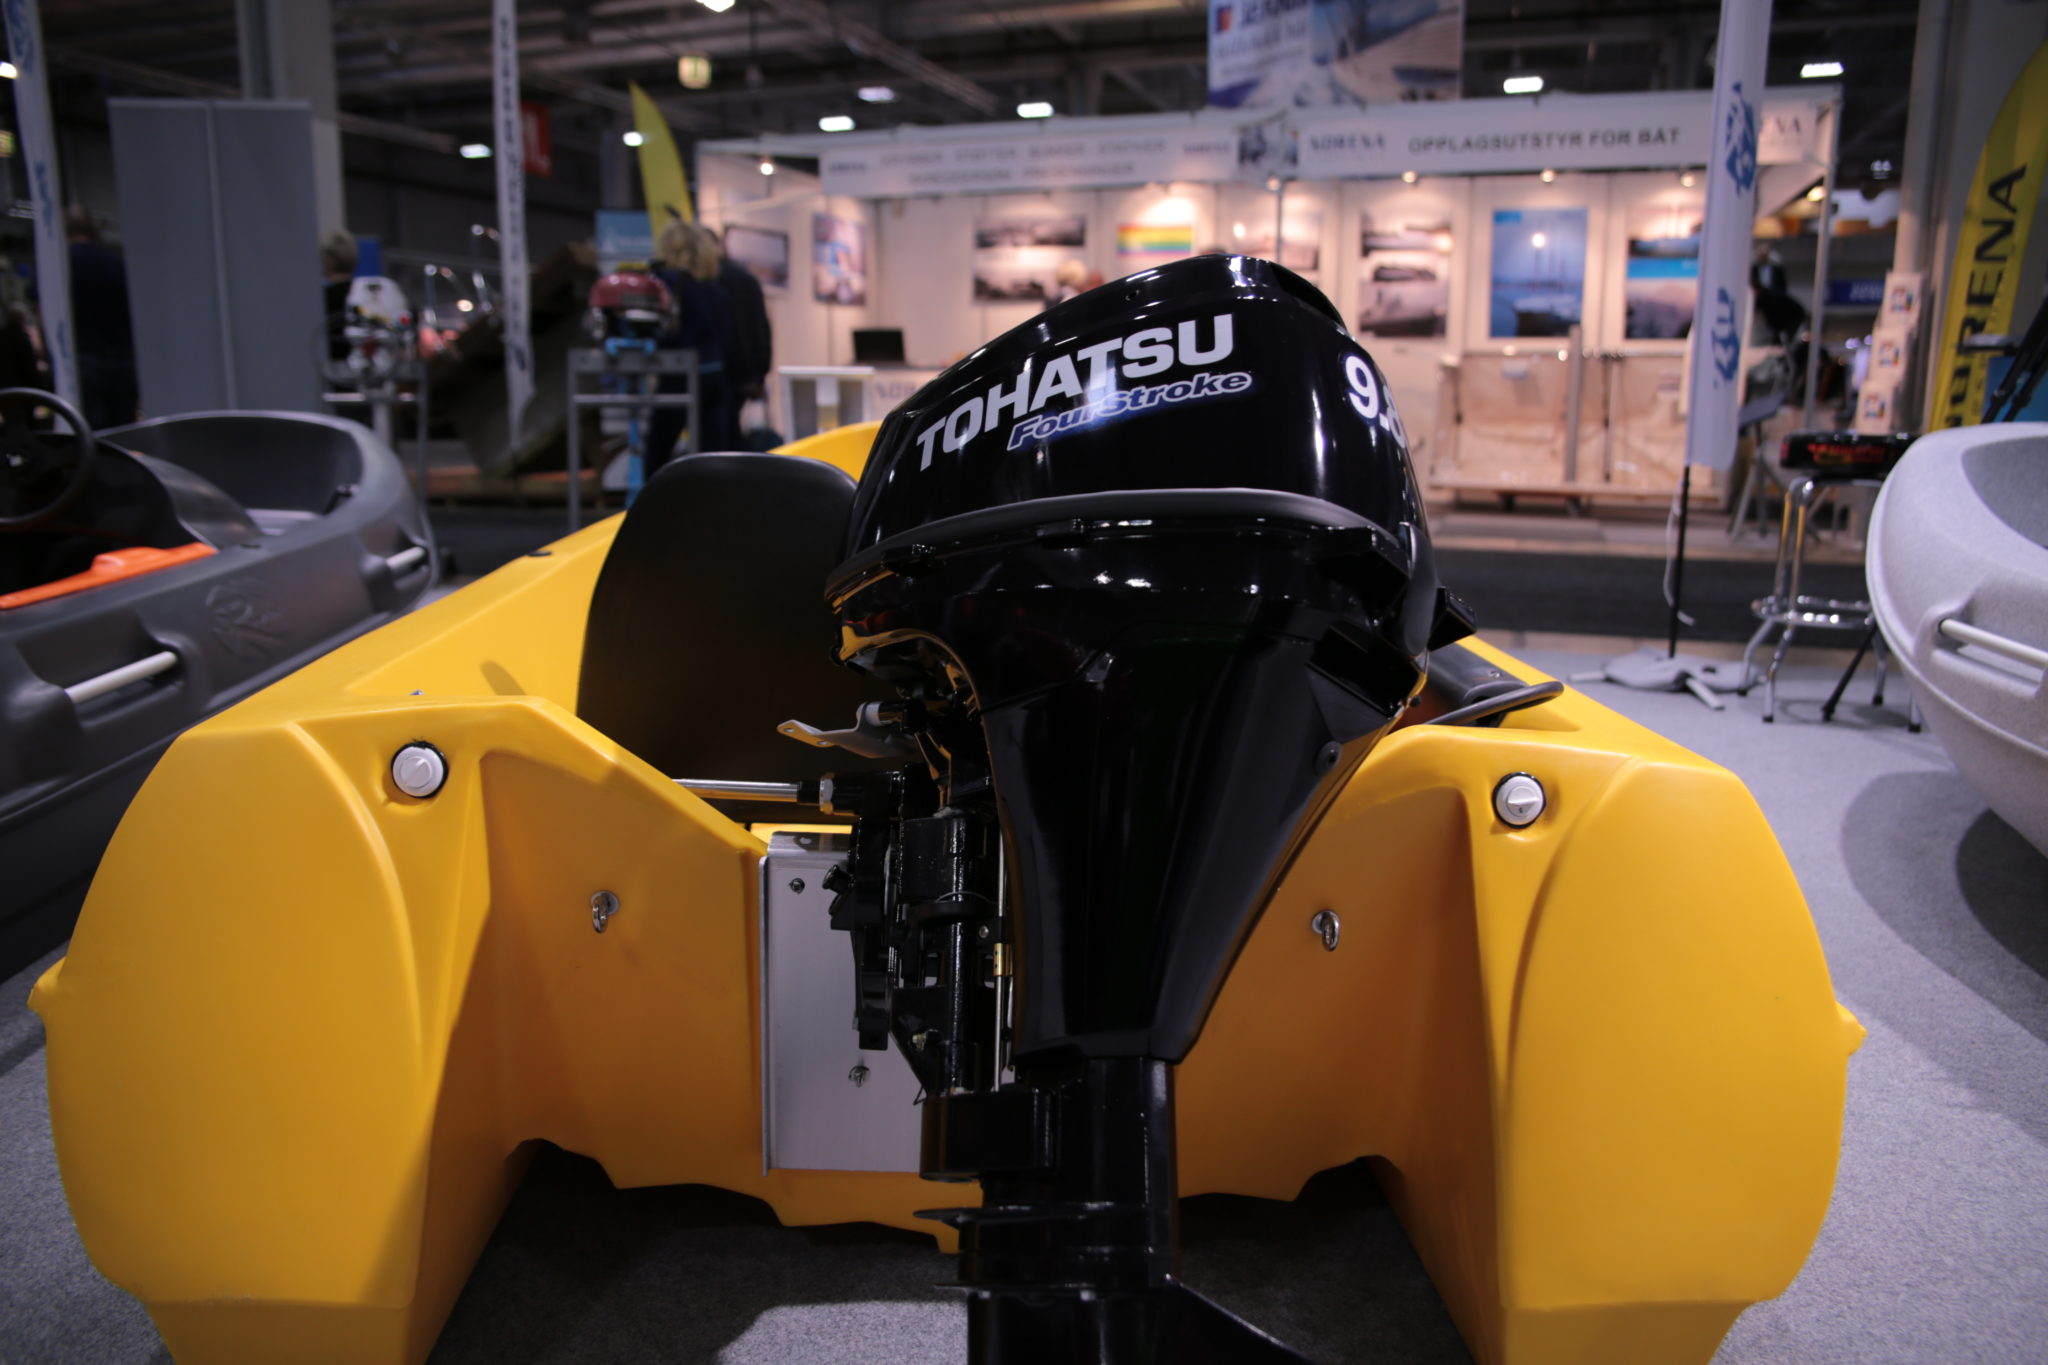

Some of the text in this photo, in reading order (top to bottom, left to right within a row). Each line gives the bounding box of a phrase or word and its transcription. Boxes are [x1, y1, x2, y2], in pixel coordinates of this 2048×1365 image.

[1408, 129, 1583, 155] OPPLAGSUTSTYR
[1588, 129, 1633, 148] FOR
[916, 313, 1234, 472] TOHATSU
[1006, 372, 1252, 451] FourStroke
